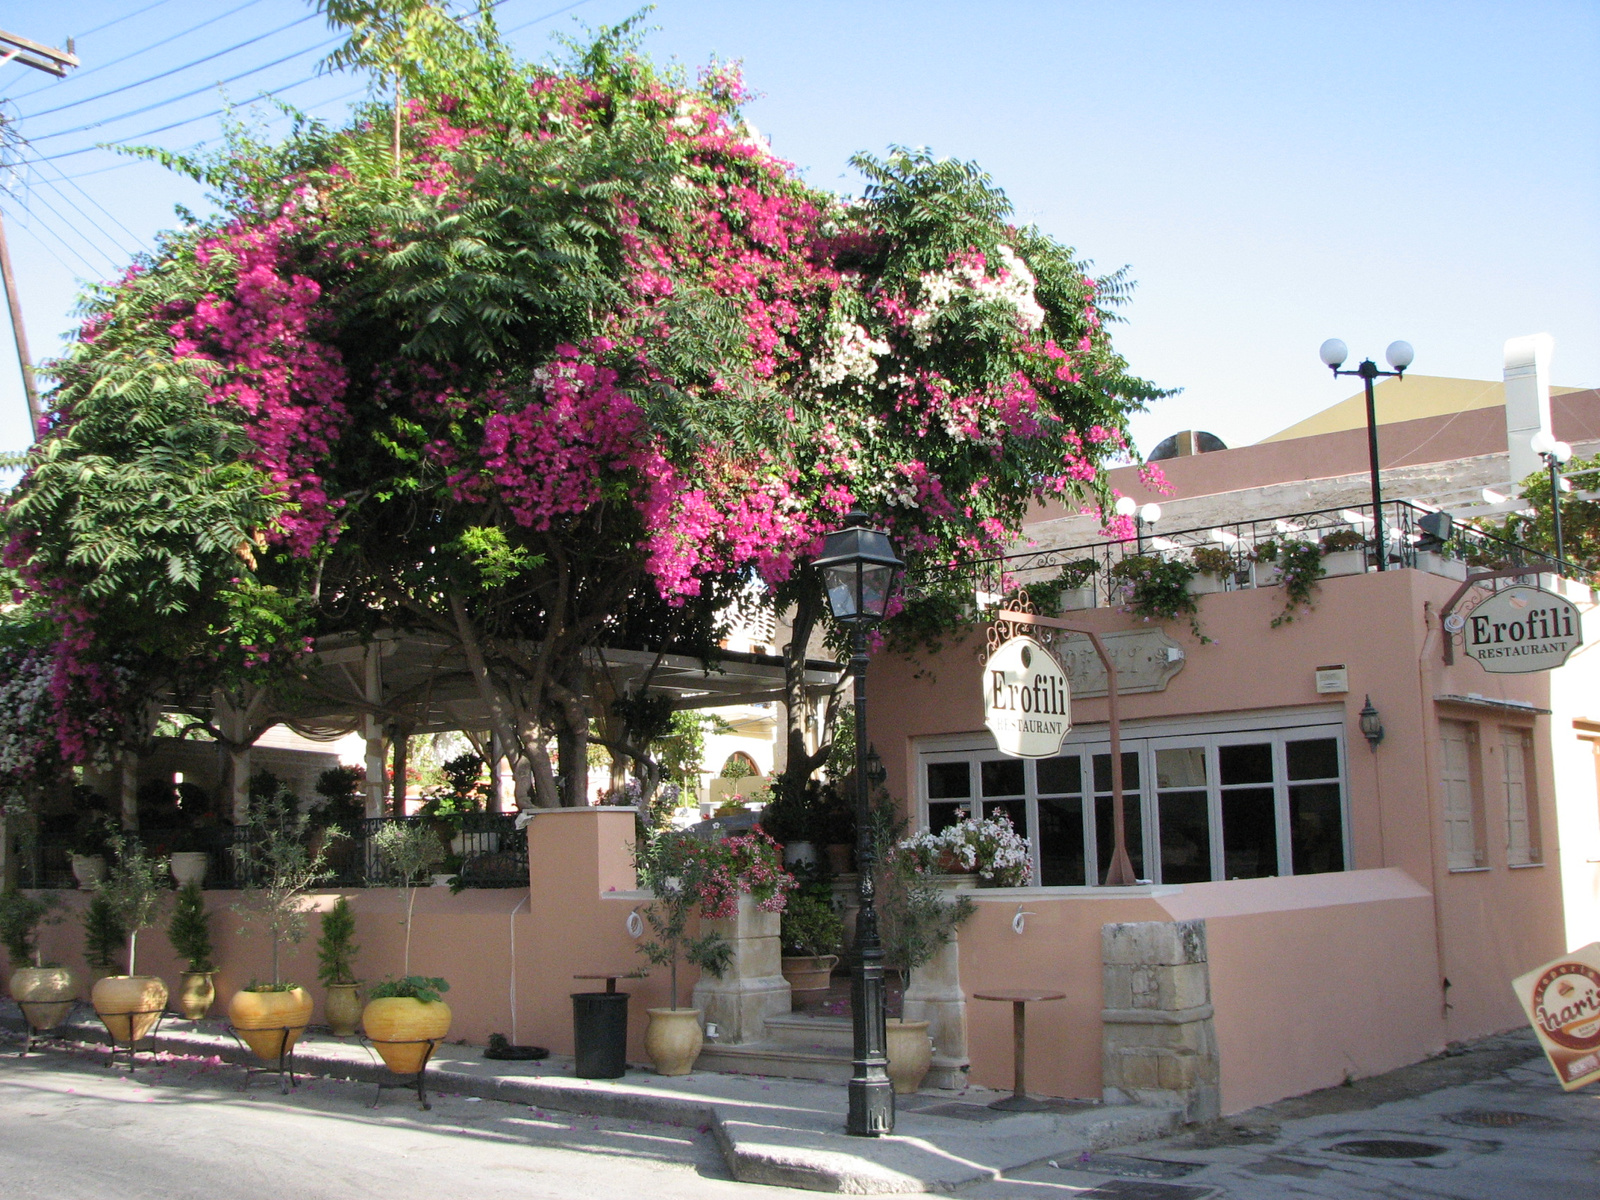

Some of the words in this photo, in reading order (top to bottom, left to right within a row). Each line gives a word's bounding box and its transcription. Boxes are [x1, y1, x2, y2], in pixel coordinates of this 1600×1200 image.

[1470, 607, 1574, 645] Erofili
[1478, 642, 1568, 659] RESTAURANT
[990, 670, 1066, 715] Erofili
